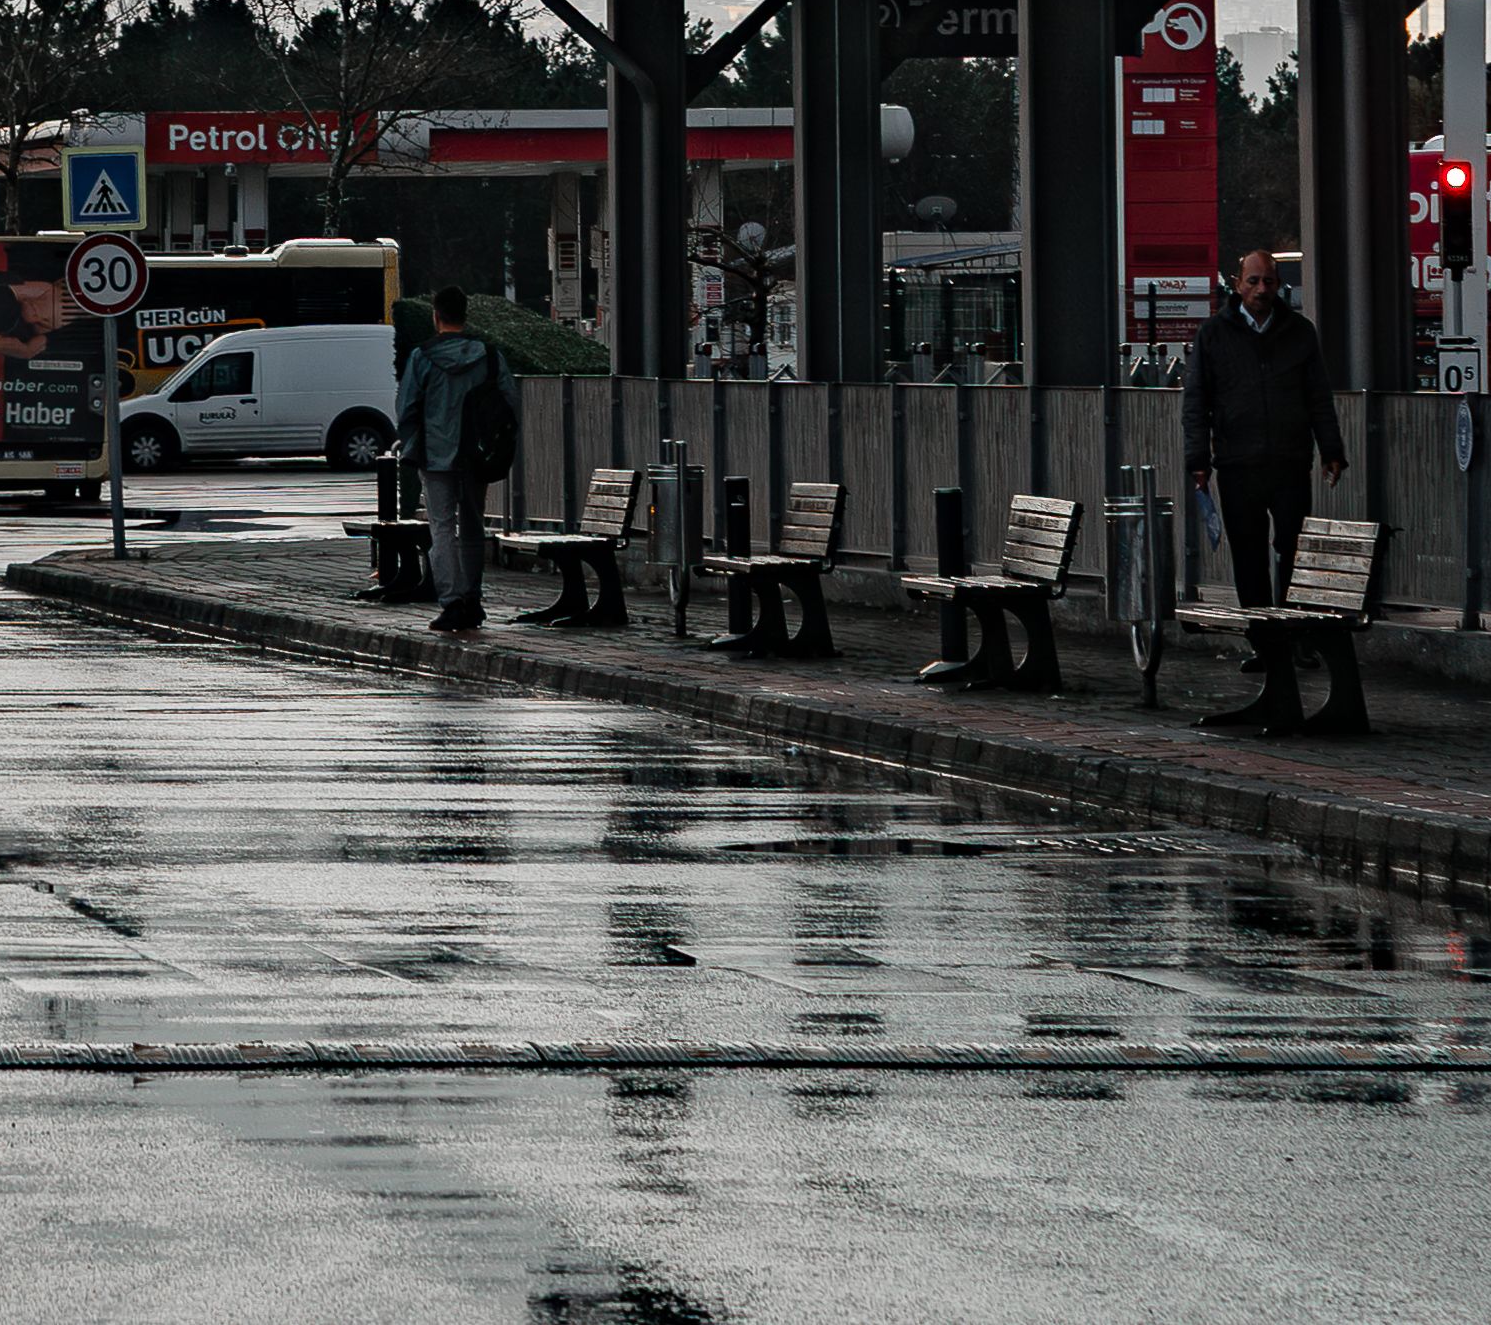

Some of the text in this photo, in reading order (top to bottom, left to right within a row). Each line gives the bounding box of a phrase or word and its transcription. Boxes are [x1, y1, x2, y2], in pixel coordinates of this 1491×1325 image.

[168, 123, 268, 152] Petrol
[83, 256, 132, 293] 30
[140, 306, 226, 326] HER GÜN
[5, 401, 76, 425] Haber
